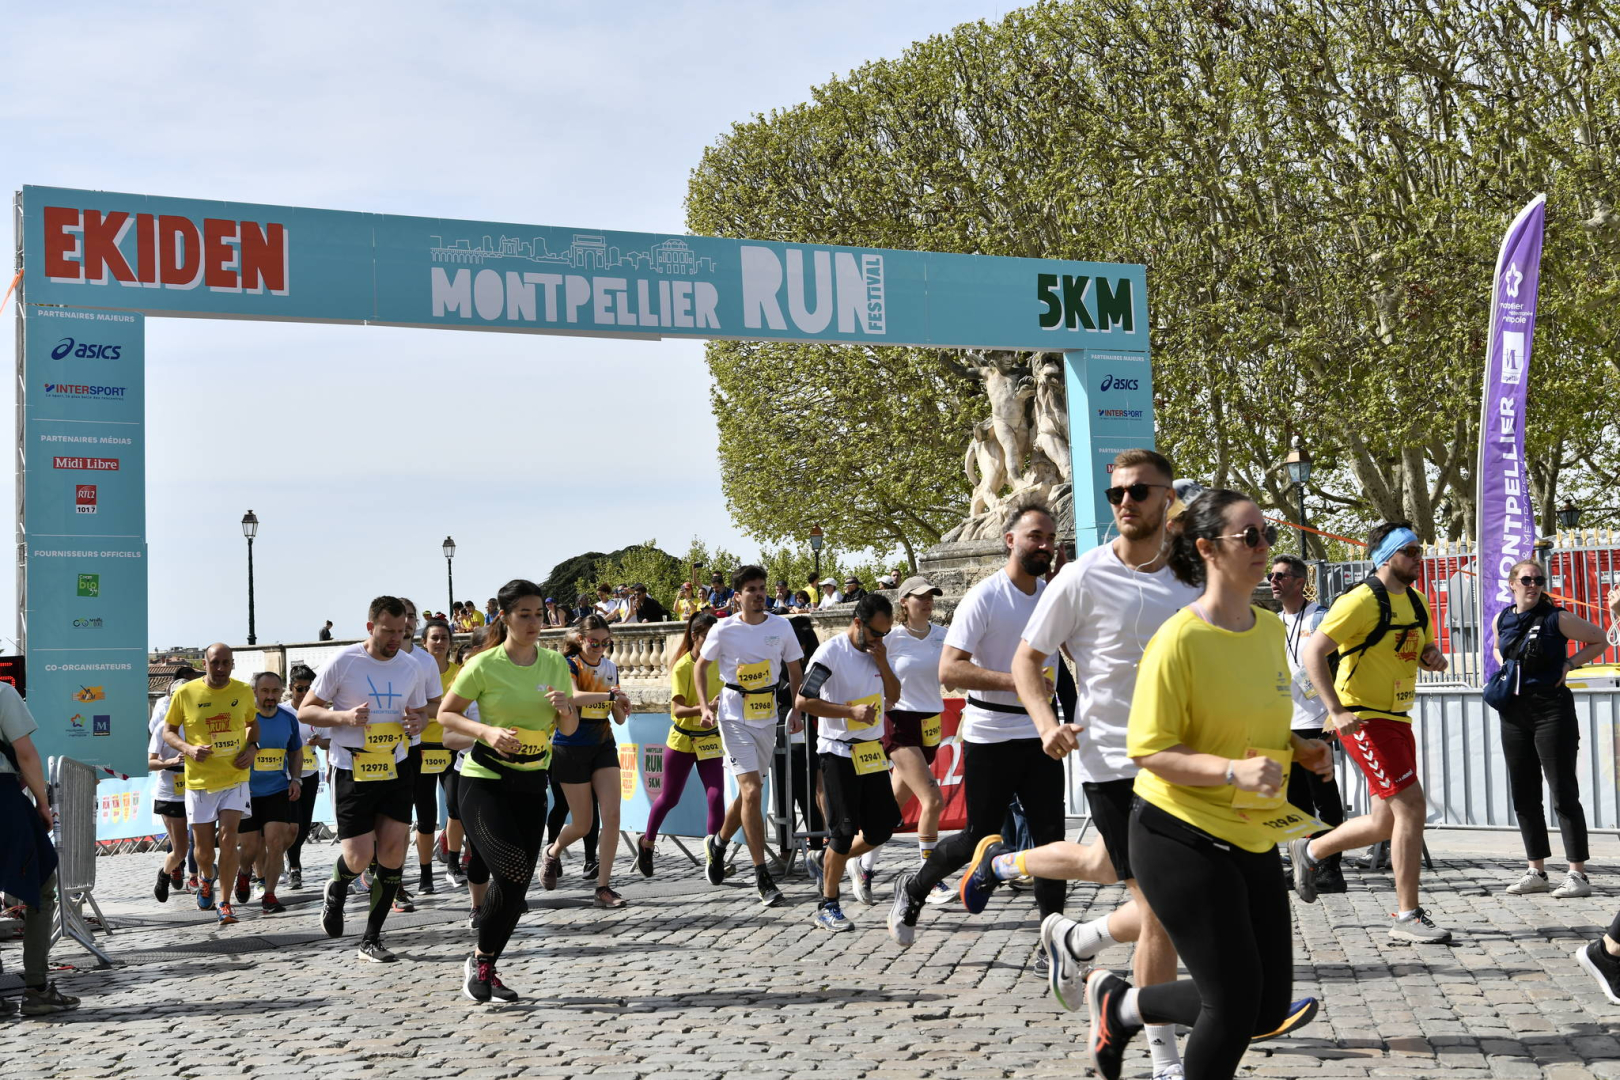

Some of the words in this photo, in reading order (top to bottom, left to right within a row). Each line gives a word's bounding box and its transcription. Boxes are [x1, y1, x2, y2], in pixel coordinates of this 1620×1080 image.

[44, 206, 288, 296] EKIDEN
[431, 267, 721, 330] MONTPELLIER
[740, 246, 869, 334] RUN
[867, 257, 882, 332] FESTIVAL
[1037, 273, 1135, 334] 5KM
[38, 309, 95, 320] PARTENAIRES
[97, 314, 135, 323] MAJEURS
[55, 384, 126, 397] INTERSPORT
[1104, 409, 1143, 418] INTERSPORT
[41, 434, 98, 444] PARTENAIRES
[99, 436, 132, 445] MÉDIAS
[55, 457, 83, 469] Midi
[86, 459, 118, 470] Libre
[78, 490, 95, 499] RTL2
[1496, 397, 1522, 604] MONTPELLIER
[34, 550, 99, 558] FOURNISSEURS
[45, 663, 132, 671] CO-ORGANISATEURS
[739, 669, 770, 681] 12968-1
[750, 702, 771, 710] 12968
[214, 739, 240, 748] 13152-1
[368, 734, 403, 744] 12978-1
[698, 743, 719, 751] 13002
[859, 752, 882, 763] 12941
[361, 763, 389, 772] 12978
[645, 755, 663, 772] RUN
[648, 777, 661, 788] 5KM
[1263, 814, 1304, 829] 12947
